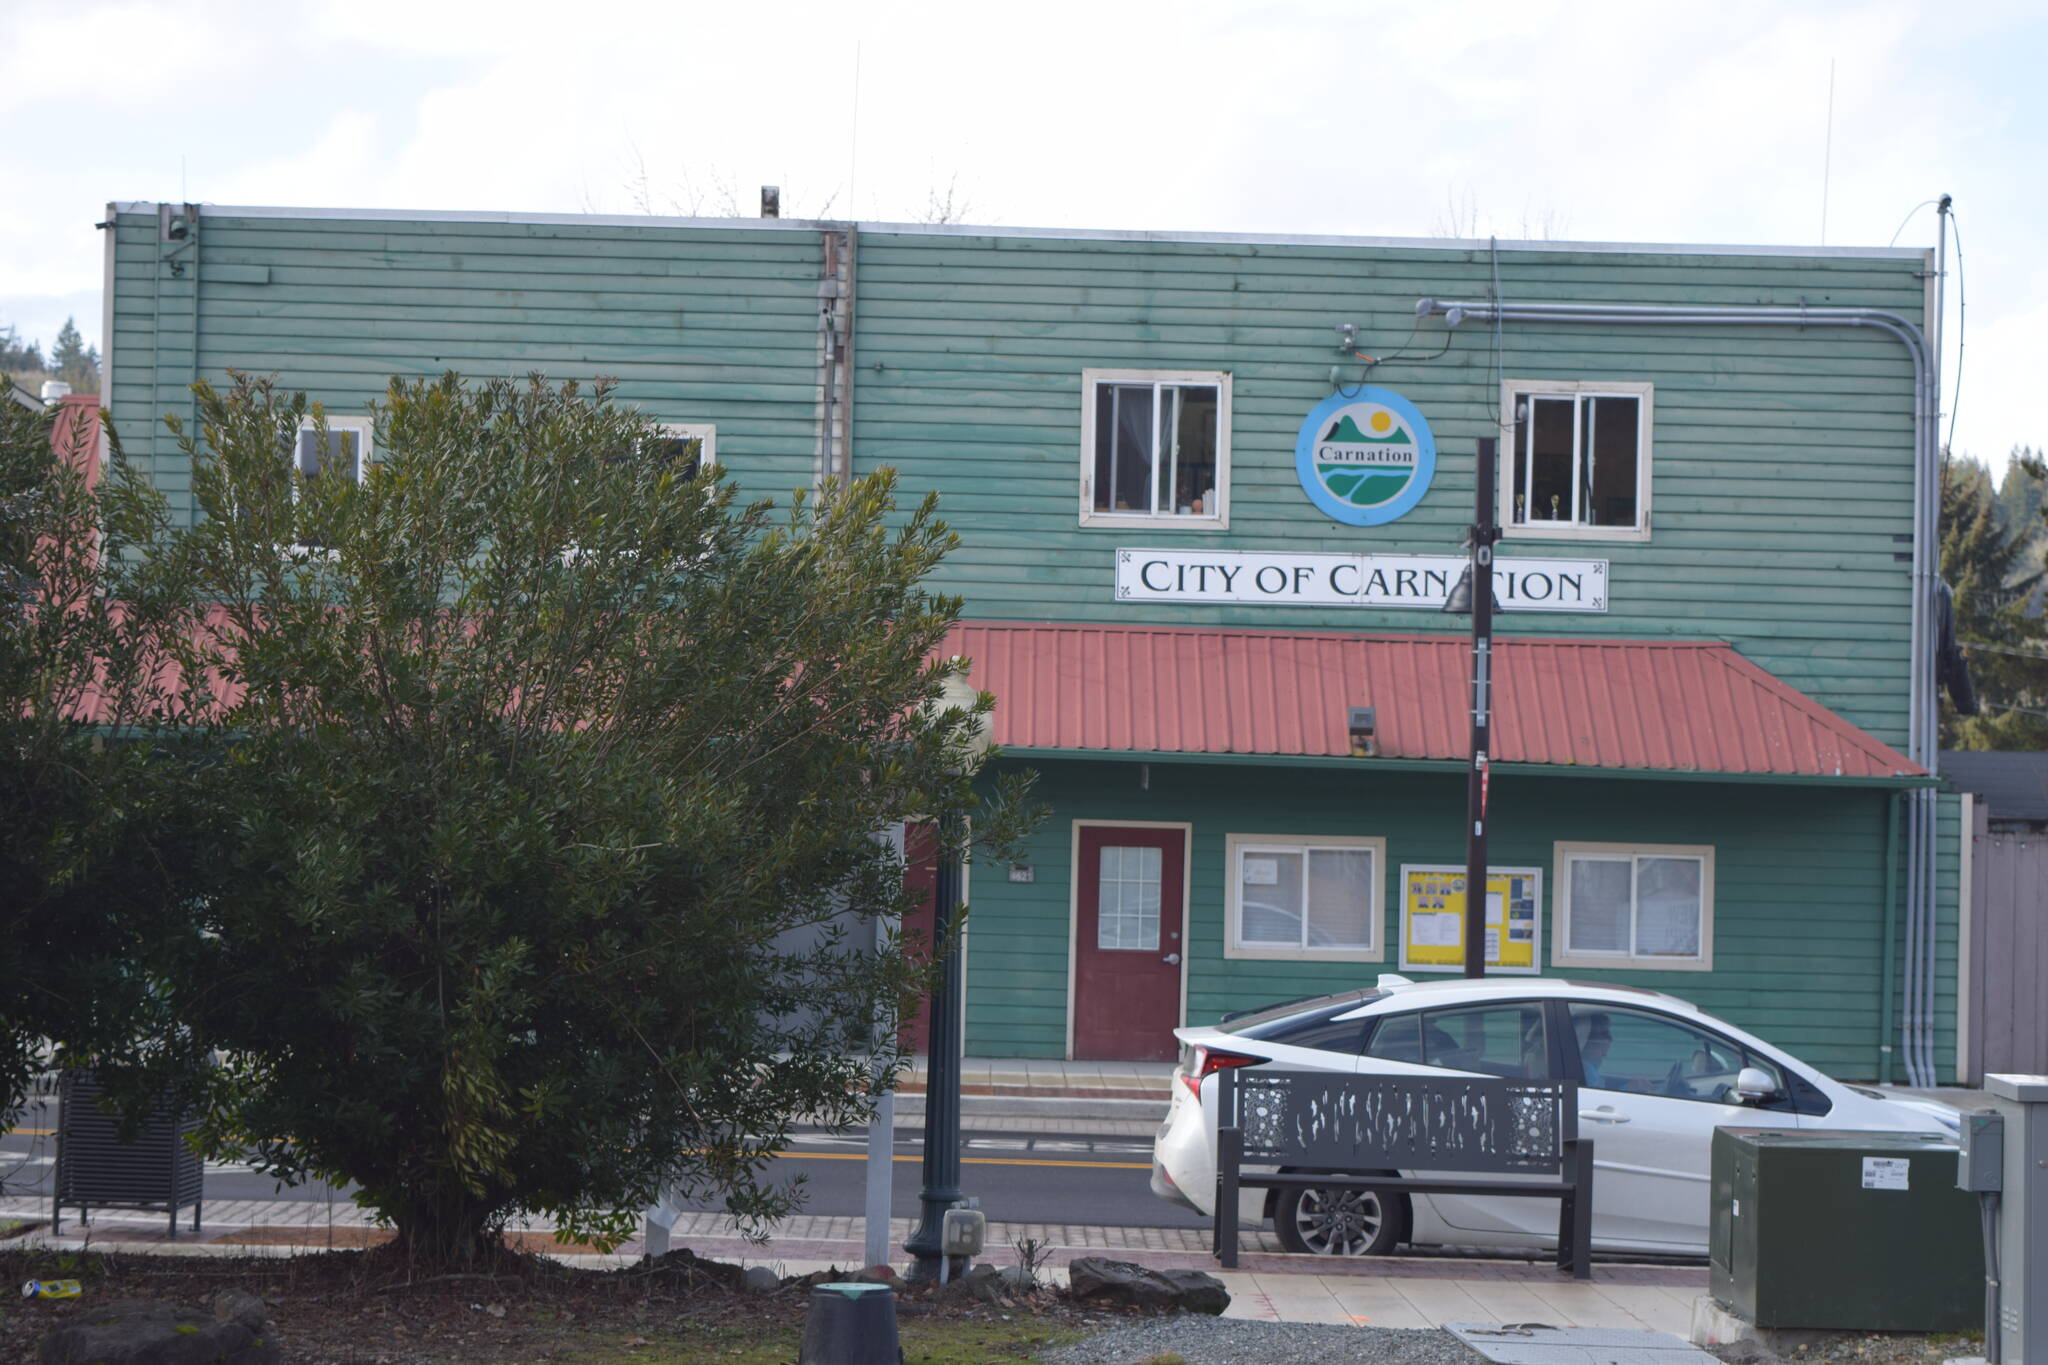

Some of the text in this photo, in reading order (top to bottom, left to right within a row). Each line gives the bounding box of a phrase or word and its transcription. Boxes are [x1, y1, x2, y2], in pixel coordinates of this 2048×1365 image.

[1318, 446, 1413, 462] Carnation
[1140, 560, 1582, 601] CITY OF CARNION
